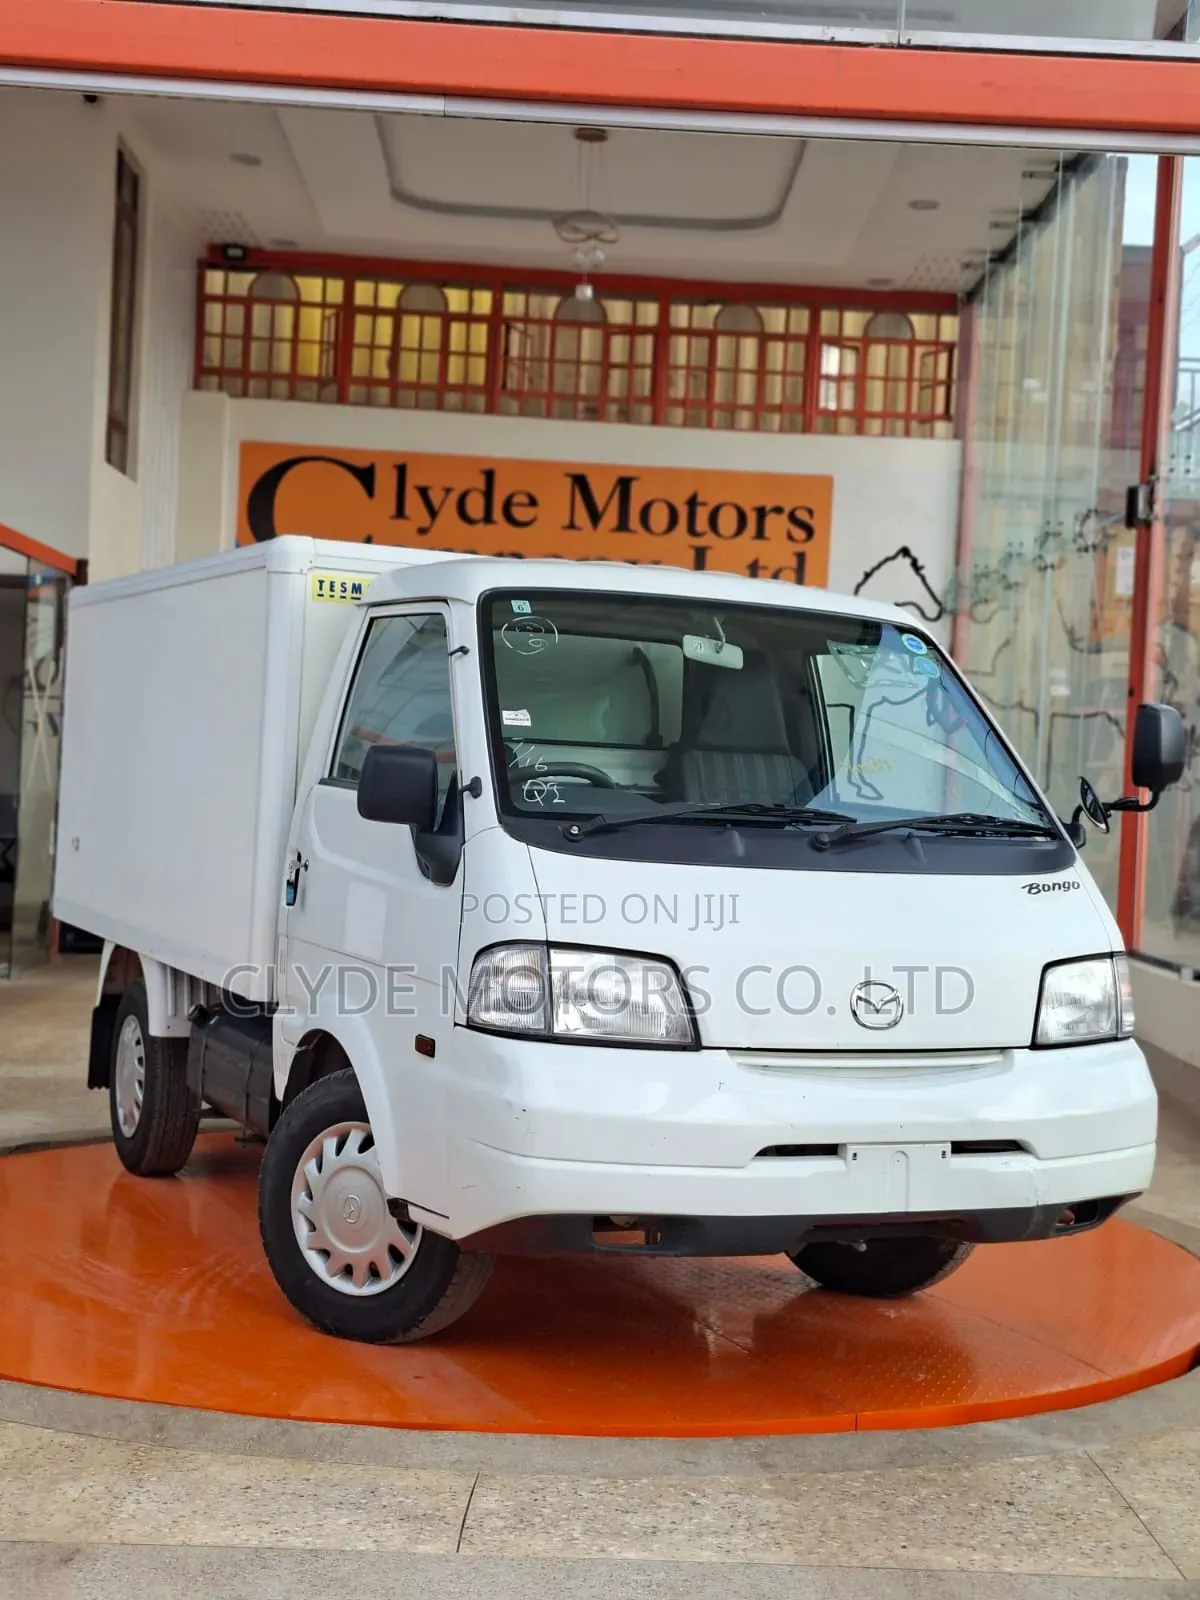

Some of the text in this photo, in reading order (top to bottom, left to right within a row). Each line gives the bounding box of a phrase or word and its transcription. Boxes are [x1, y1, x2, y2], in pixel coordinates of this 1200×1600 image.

[246, 455, 816, 544] Clyde Motors
[317, 579, 370, 595] TESM
[1020, 880, 1081, 895] Bongo
